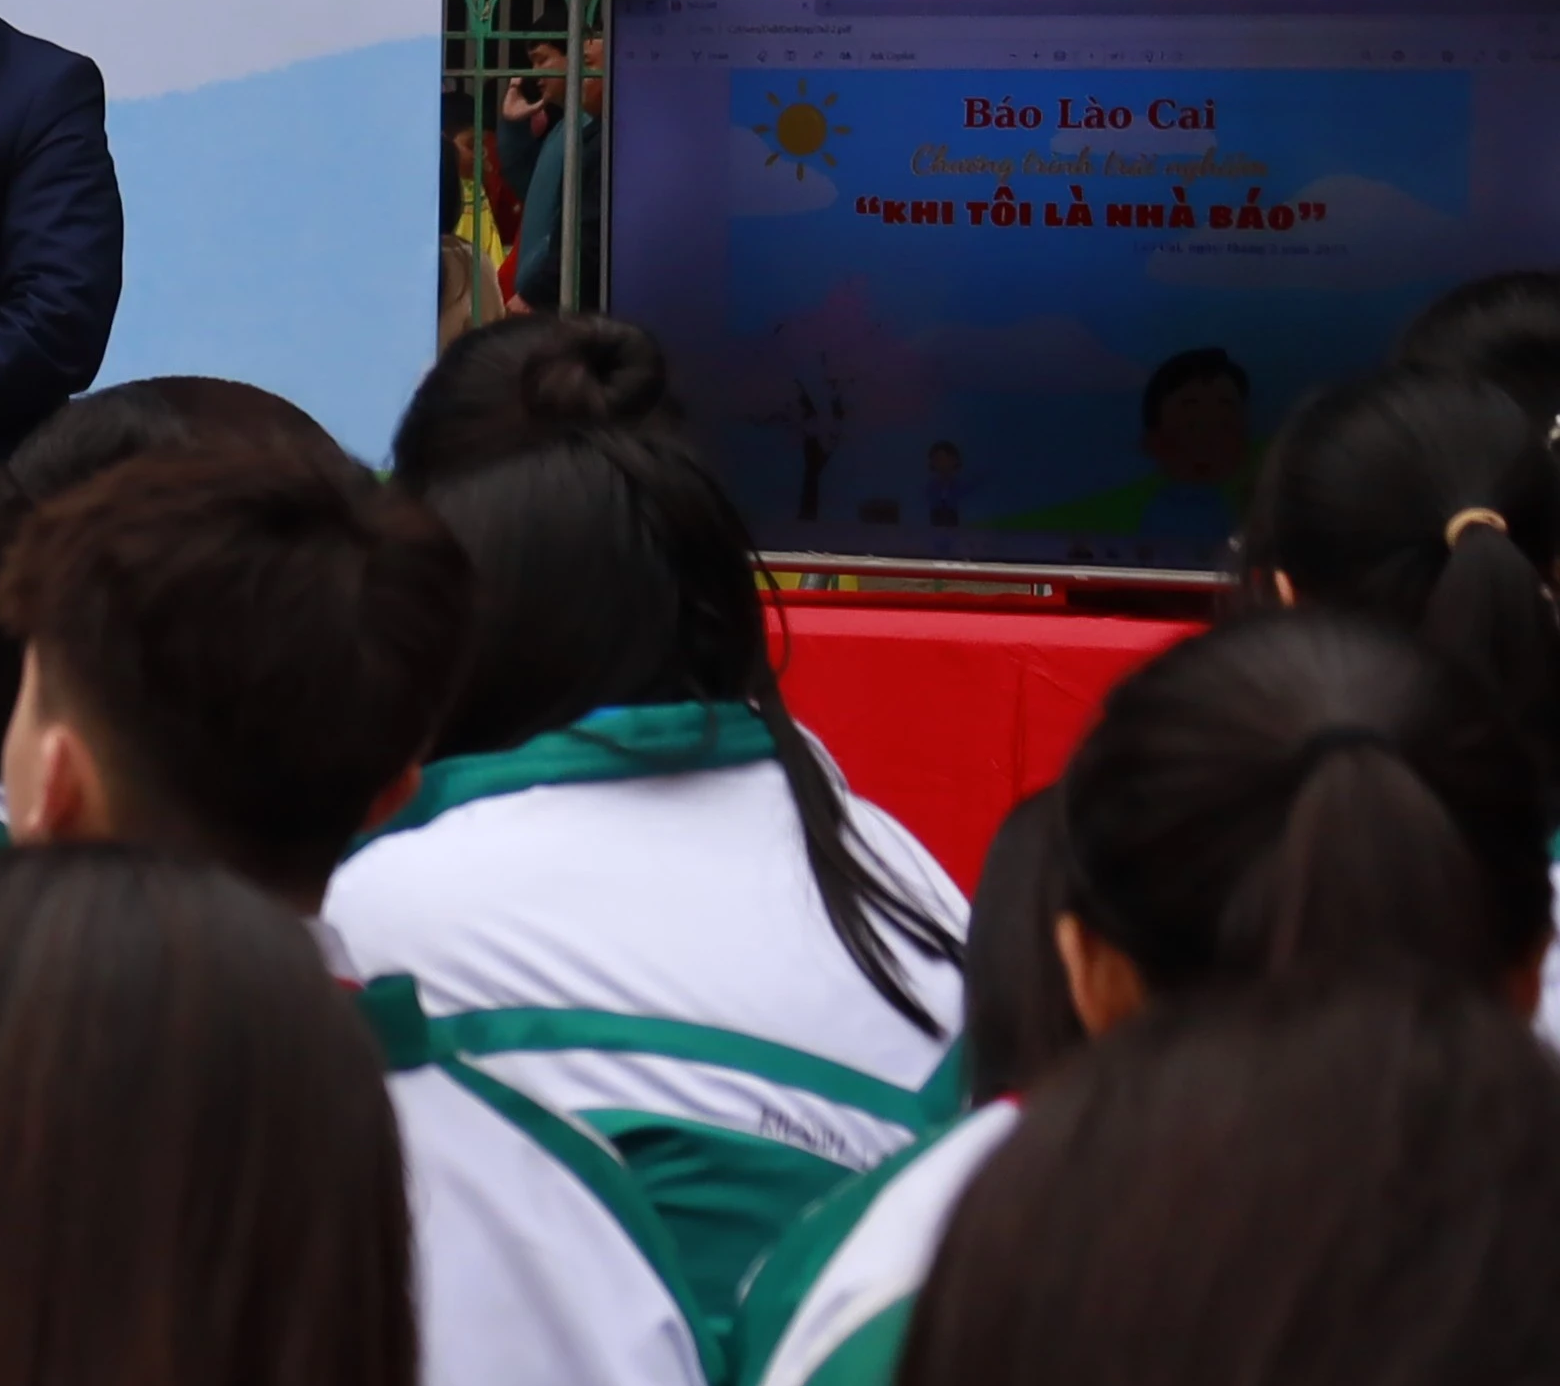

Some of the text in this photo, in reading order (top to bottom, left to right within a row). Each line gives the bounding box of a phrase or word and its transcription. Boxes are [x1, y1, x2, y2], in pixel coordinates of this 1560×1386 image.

[962, 94, 1217, 131] Báo Lào Cai
[966, 185, 1032, 227] TÔI
[1043, 186, 1094, 227] LÀ
[1106, 187, 1196, 229] NHÀ
